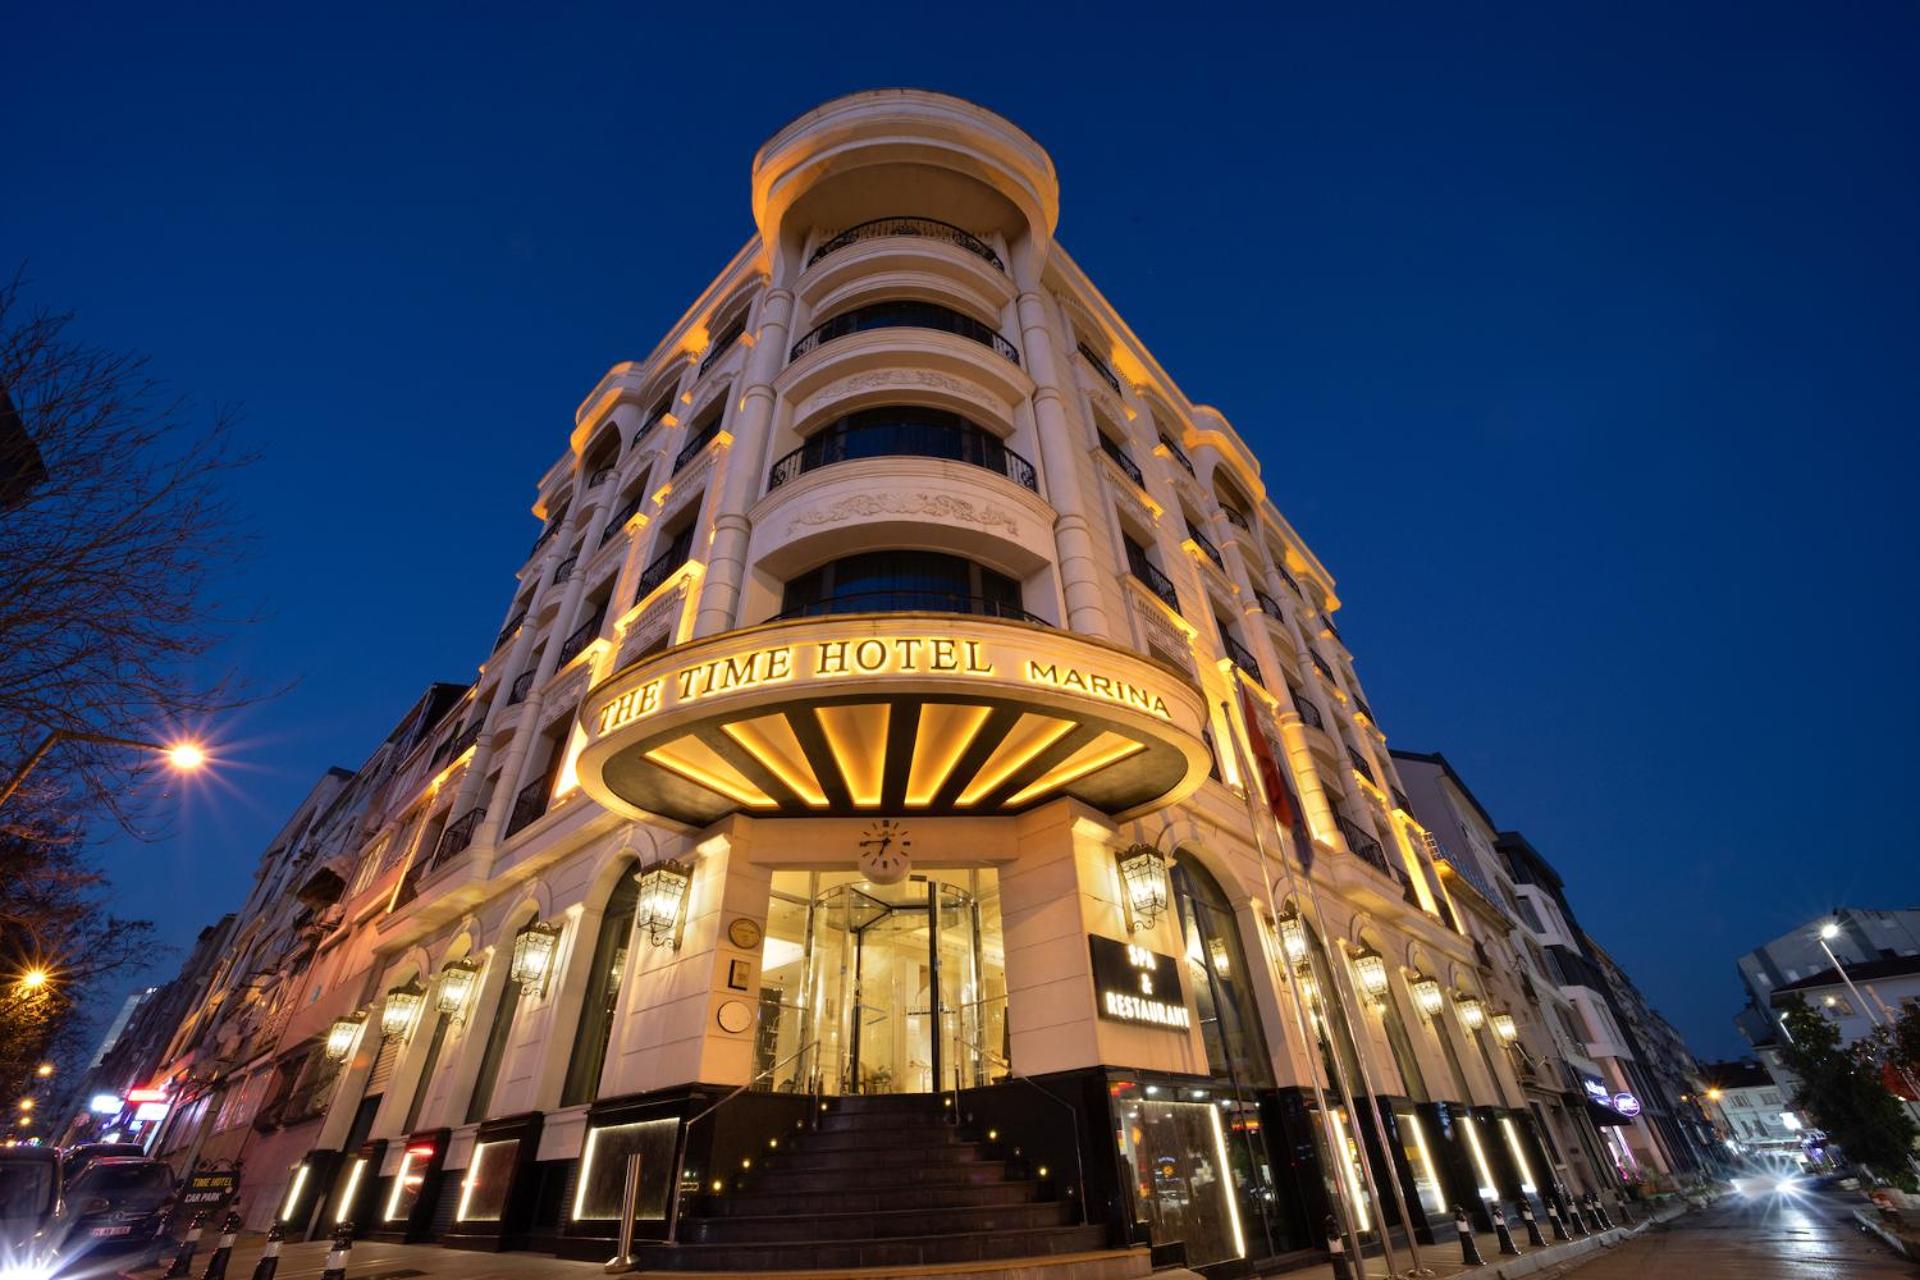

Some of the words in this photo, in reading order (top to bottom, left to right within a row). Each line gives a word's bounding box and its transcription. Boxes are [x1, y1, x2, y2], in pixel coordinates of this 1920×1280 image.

[598, 680, 660, 735] THE
[679, 647, 791, 700] TIME
[816, 639, 993, 674] HOTEL
[1127, 943, 1157, 971] SPA
[1141, 972, 1153, 995] &
[1105, 991, 1191, 1029] RESTAURANT
[211, 1176, 233, 1187] HOTEL
[184, 1193, 202, 1203] CAR
[201, 1191, 222, 1202] PARK
